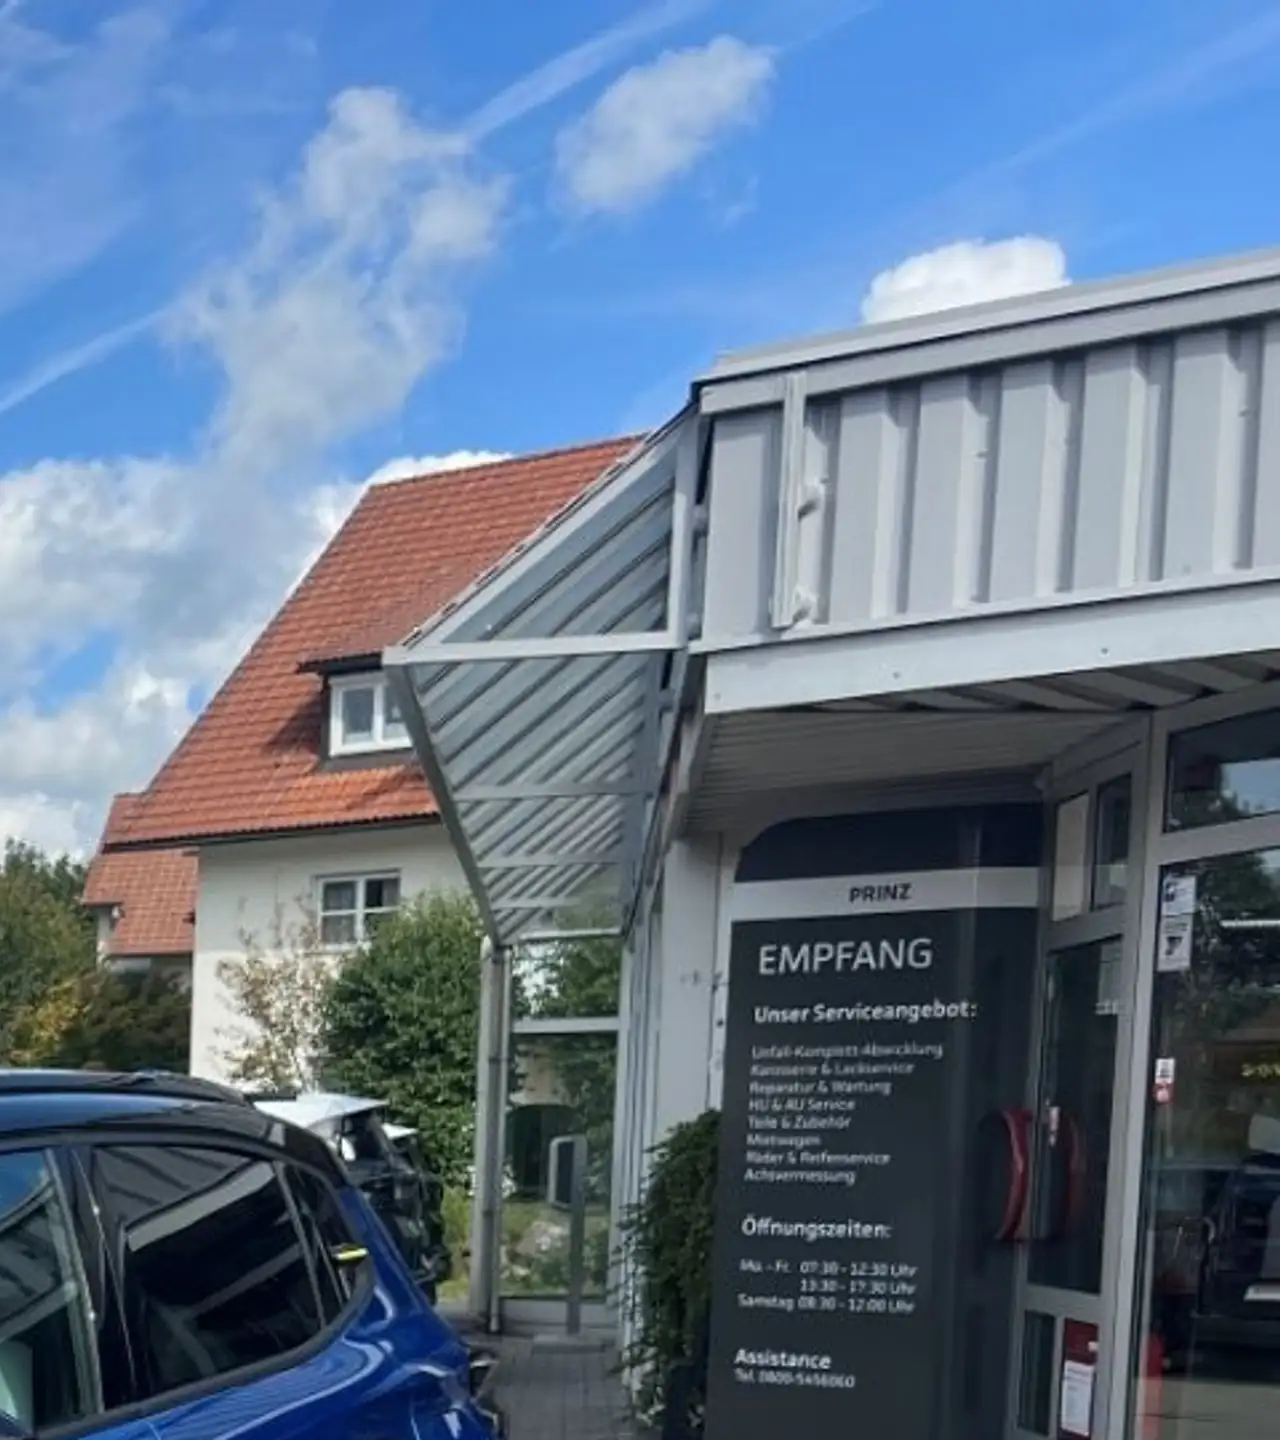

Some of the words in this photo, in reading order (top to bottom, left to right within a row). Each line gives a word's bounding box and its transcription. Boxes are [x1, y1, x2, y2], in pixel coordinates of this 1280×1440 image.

[849, 882, 913, 903] PRINZ
[758, 937, 933, 975] EMPFANG
[754, 1005, 811, 1024] Unser
[814, 999, 977, 1023] Serviceangebot:
[748, 1098, 769, 1112] HU
[807, 1098, 856, 1112] Service
[741, 1213, 893, 1242] Öffnungszeiten:
[733, 1348, 831, 1370] Assistance
